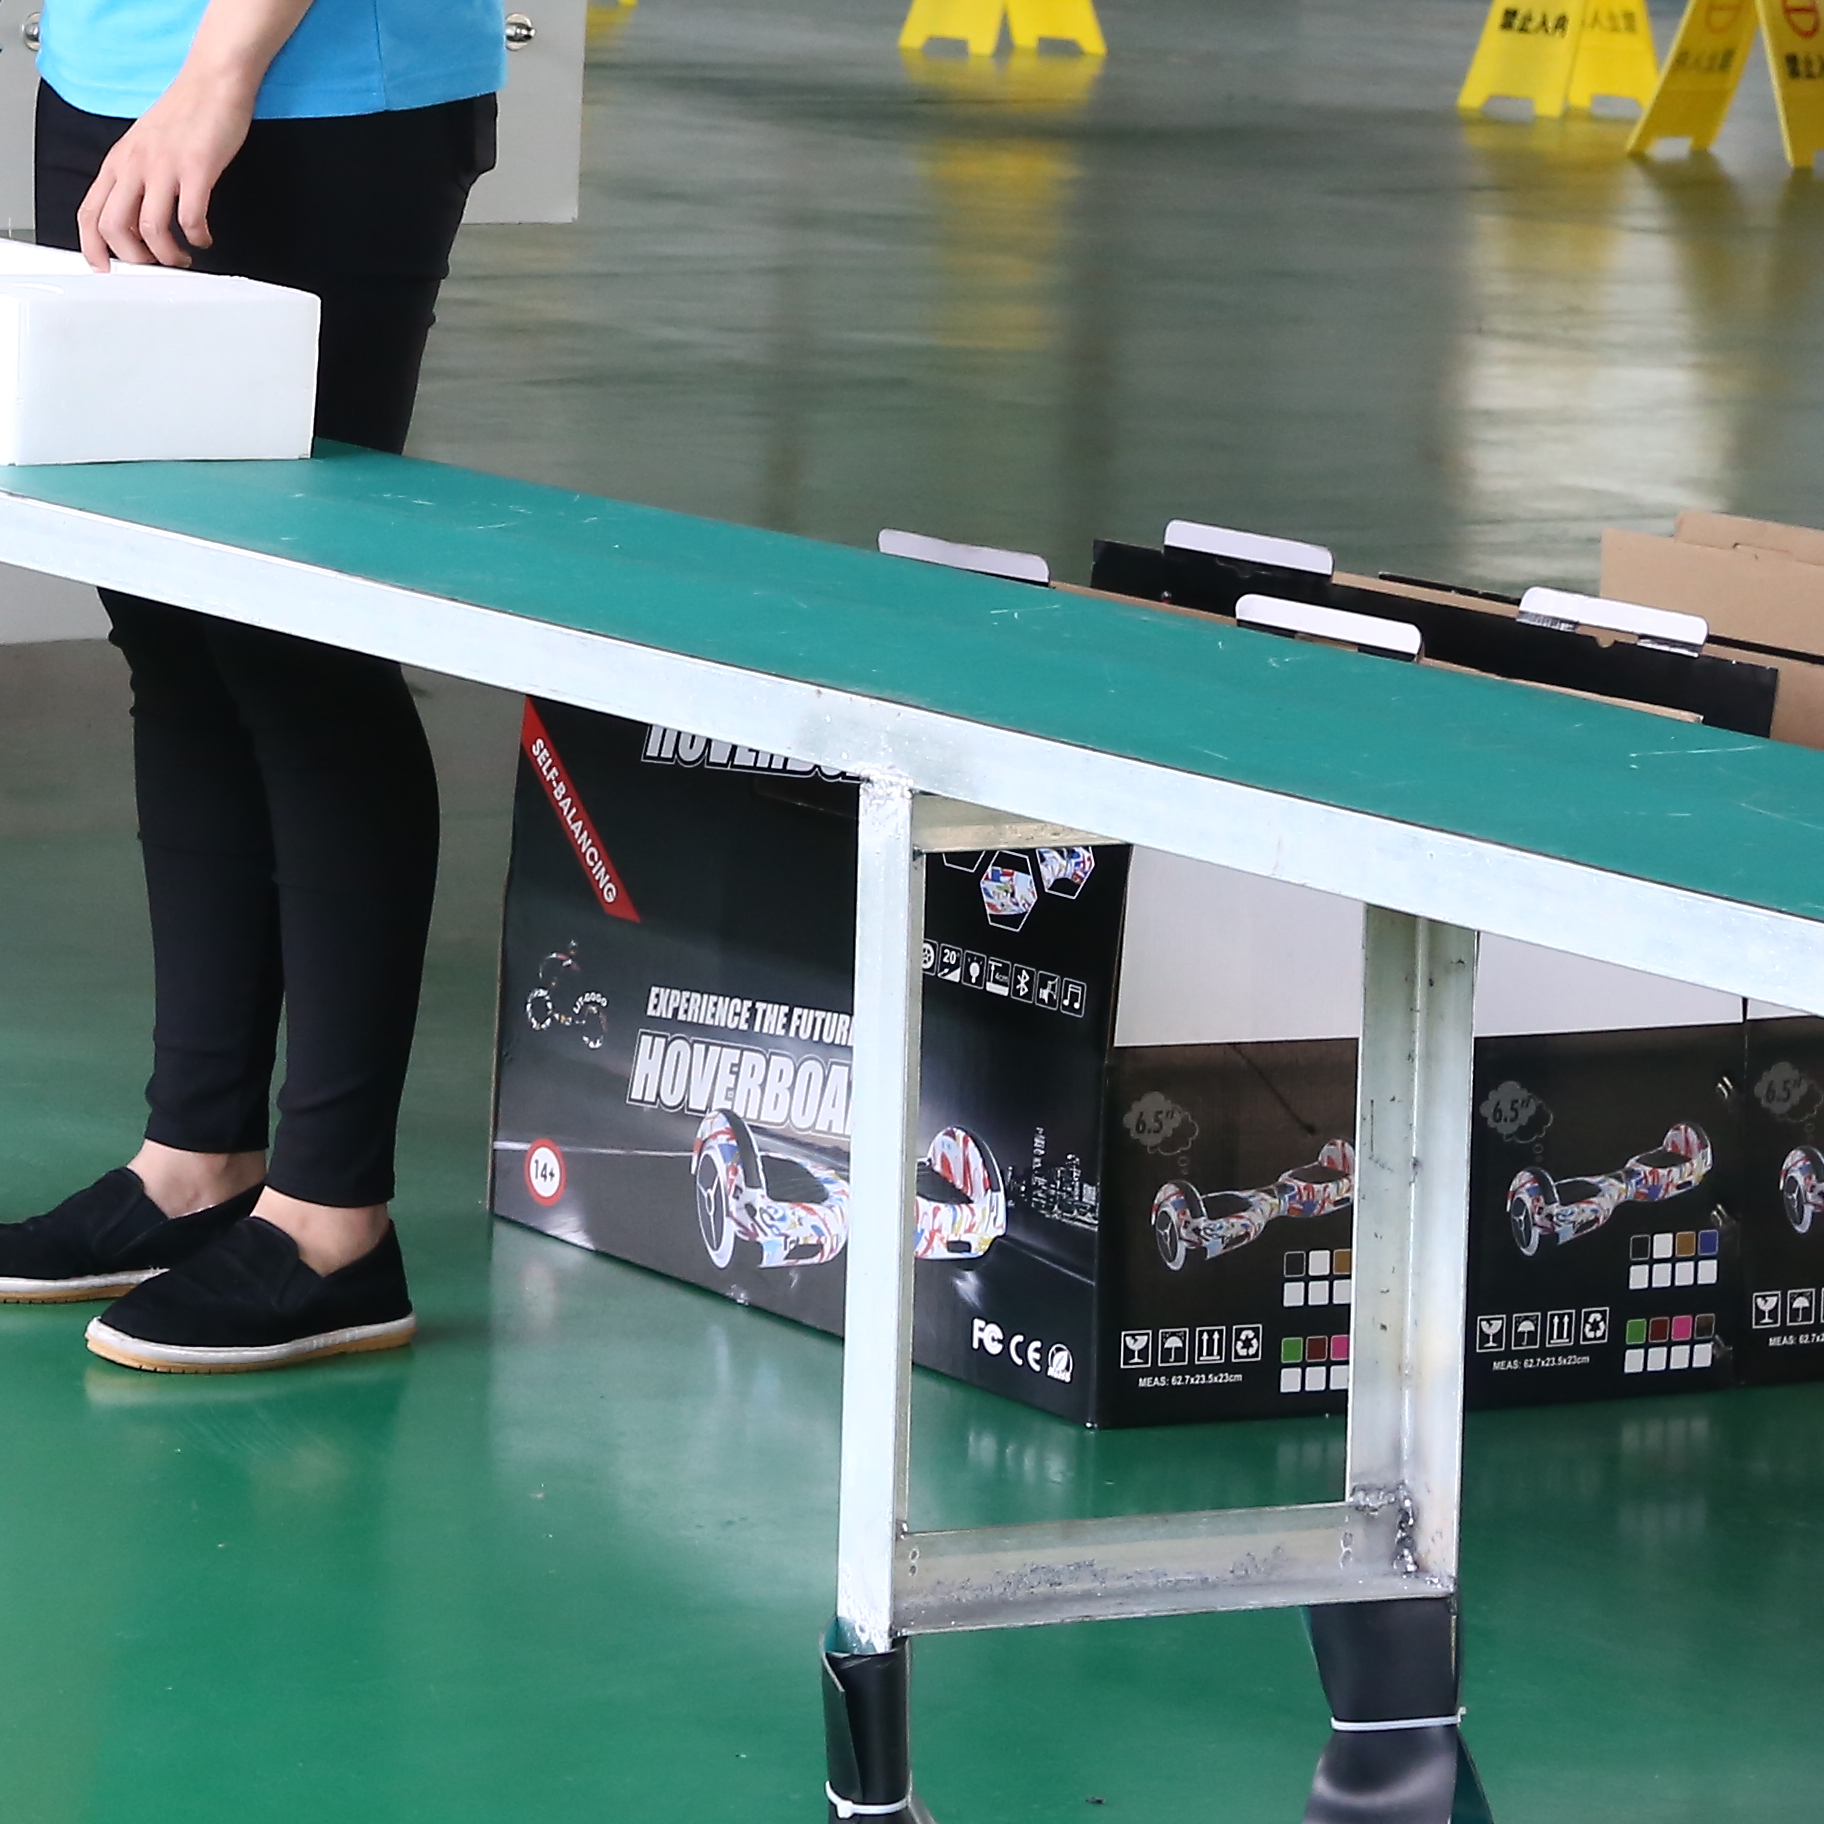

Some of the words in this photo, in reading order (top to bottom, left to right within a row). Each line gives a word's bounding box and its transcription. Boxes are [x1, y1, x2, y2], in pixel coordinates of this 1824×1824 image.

[531, 737, 618, 904] SELF-BALANCING
[646, 985, 753, 1032] EXPERIENCE
[753, 1001, 790, 1037] THE
[627, 1030, 853, 1138] HOVERBOA
[534, 1158, 556, 1183] 14+
[1009, 1334, 1042, 1373] CE
[1769, 1335, 1797, 1347] MEAS:
[1492, 1359, 1522, 1371] MEAS:
[1523, 1354, 1591, 1370] 62.7x23.5x23cm
[1138, 1376, 1170, 1388] MEAS:
[1170, 1372, 1243, 1387] 62.7x23.5x23cm
